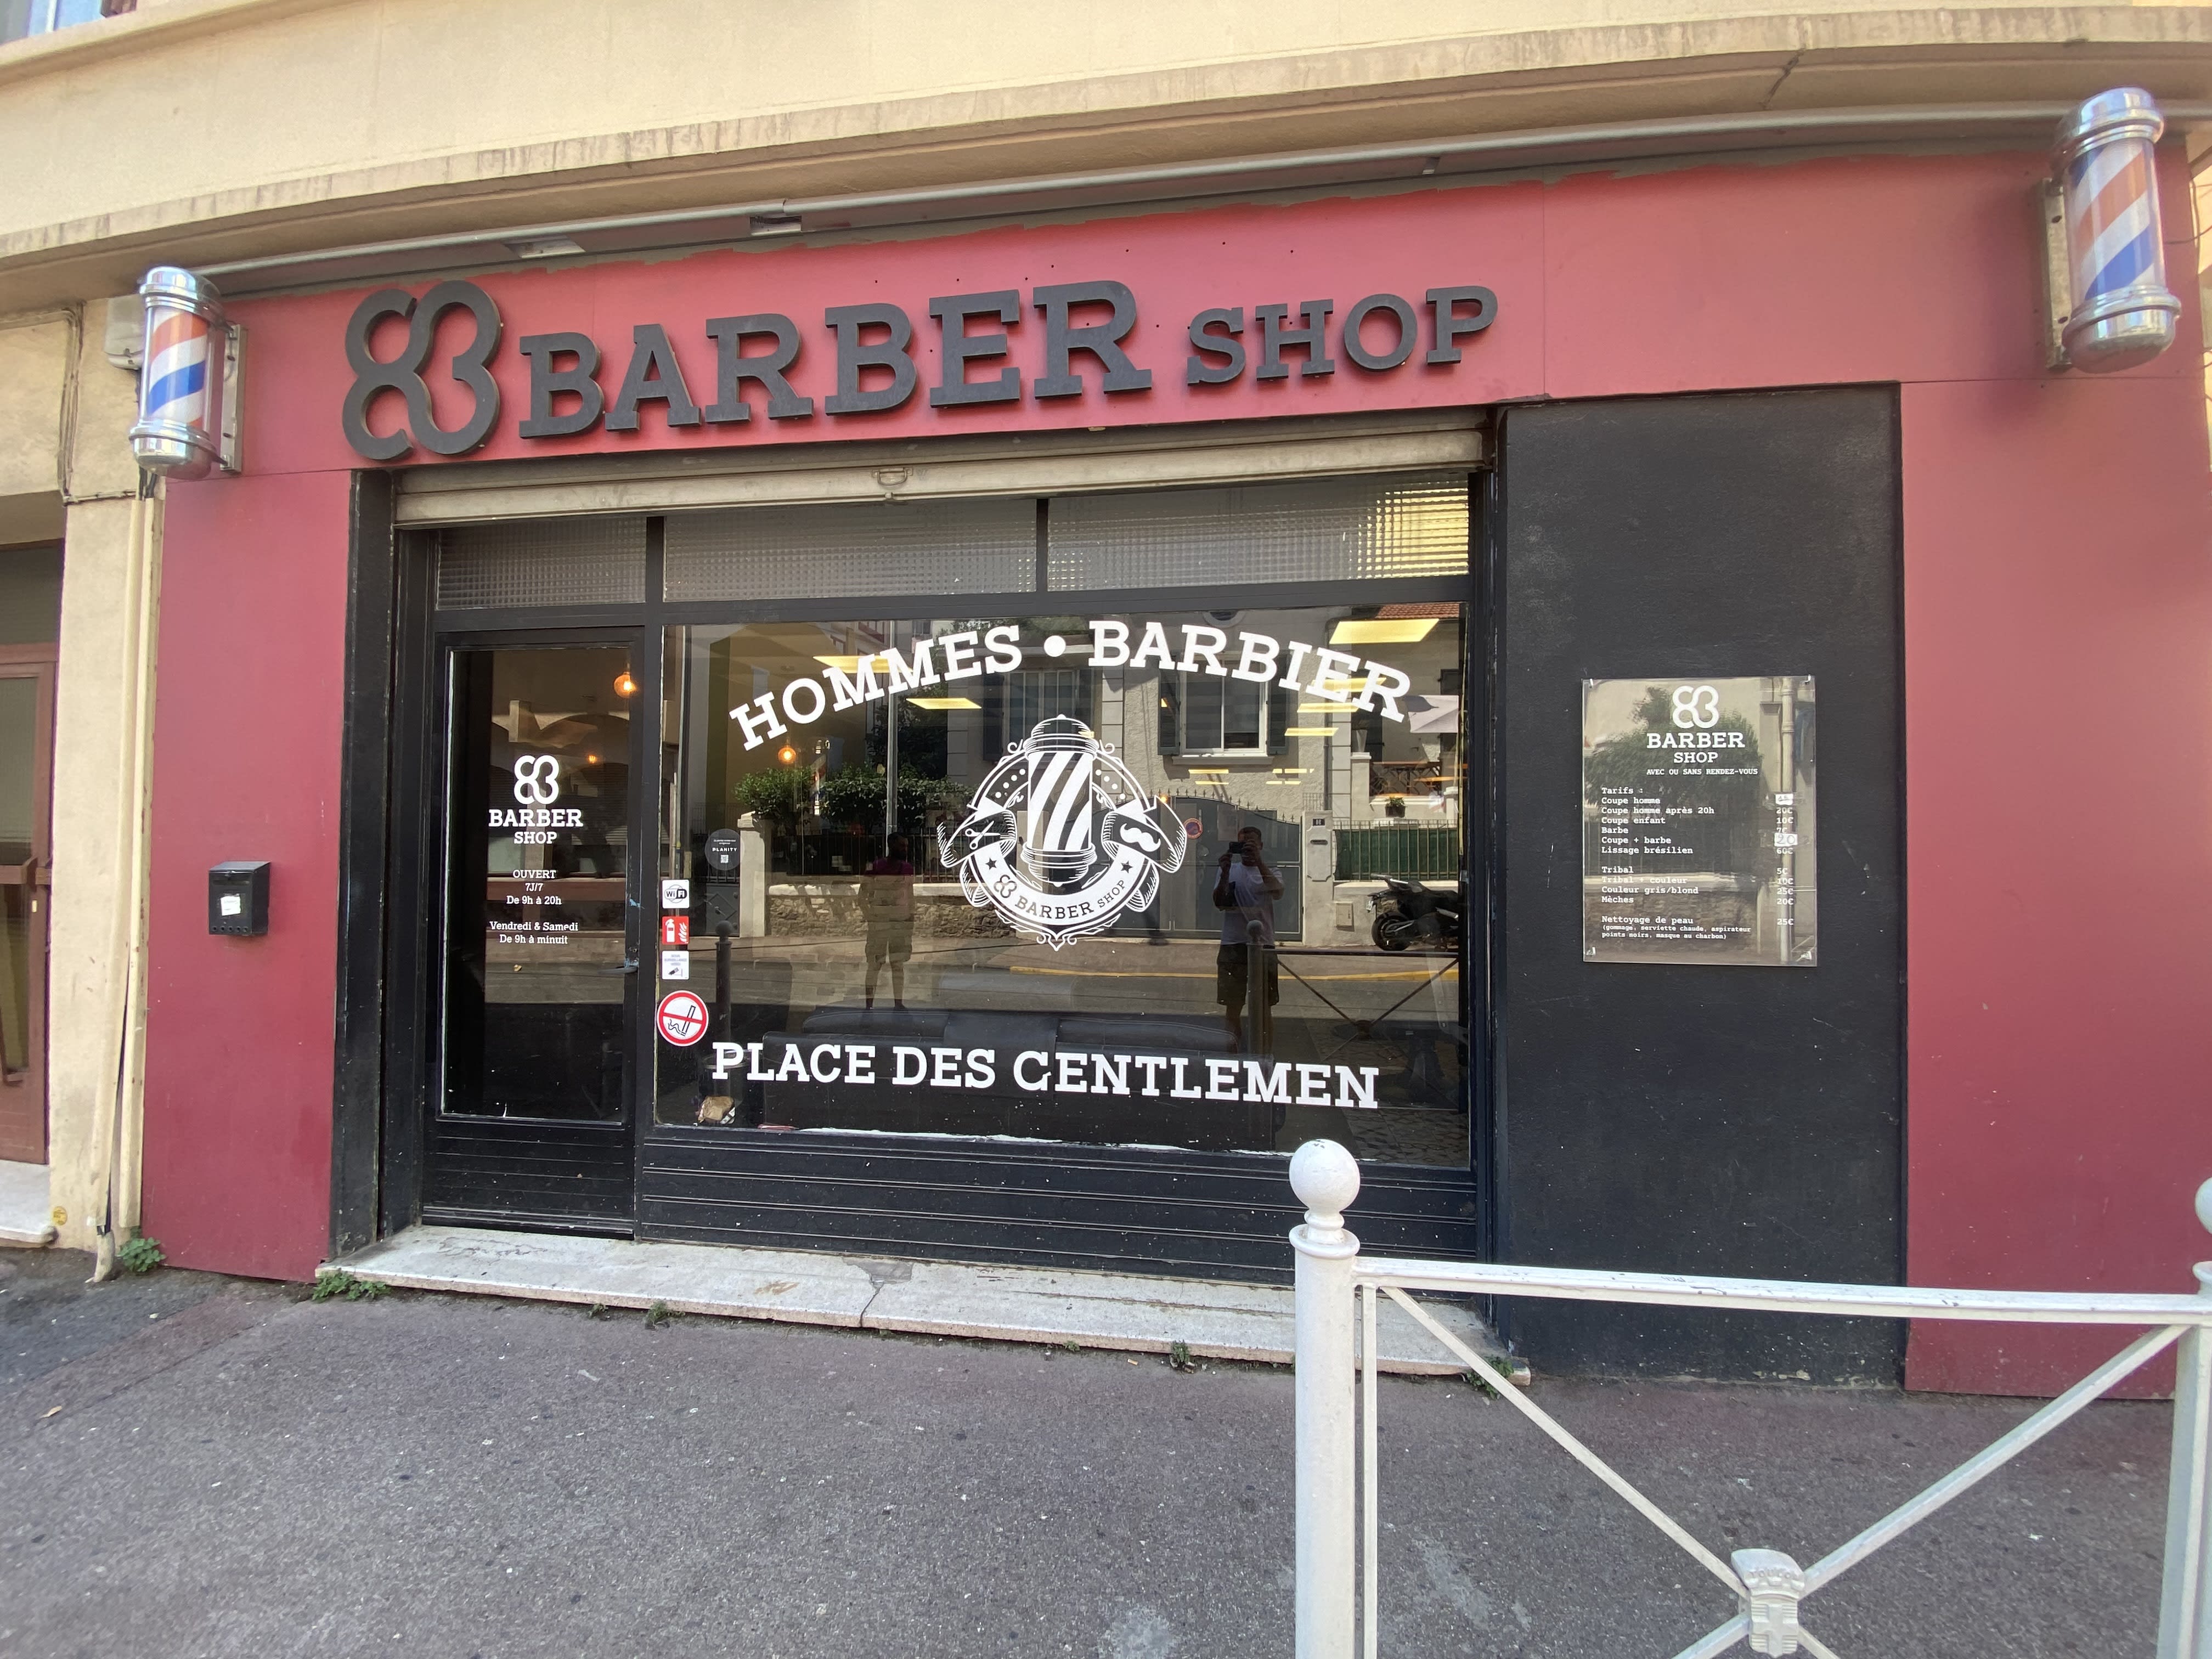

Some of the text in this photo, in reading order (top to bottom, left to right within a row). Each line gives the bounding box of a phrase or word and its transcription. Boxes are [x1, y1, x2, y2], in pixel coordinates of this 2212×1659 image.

[342, 280, 1498, 460] 83 BARBER SHOP
[729, 620, 1410, 751] HOMMES BARBIER
[1646, 732, 1745, 748] BARBER
[1674, 752, 1718, 763] SHOP
[1601, 797, 1629, 805] Coupe
[1666, 806, 1693, 815] après
[488, 809, 583, 827] BARBER
[1601, 817, 1629, 825] Coupe
[514, 831, 557, 844] SHOP
[1601, 837, 1629, 845] Coupe
[1777, 834, 1796, 845] 20
[1601, 847, 1639, 855] Lissage
[512, 870, 556, 879] OUVERT
[1644, 887, 1699, 895] gris/blond
[506, 895, 562, 905] De 9h à 20h
[1015, 895, 1094, 919] BARBER
[1097, 880, 1126, 909] SHOP
[1601, 916, 1650, 924] Nettoyage
[489, 921, 578, 931] Vendredi & Samedi
[499, 934, 568, 944] De 9h à minuit
[712, 1041, 876, 1085] PLACE
[891, 1046, 996, 1090] DES
